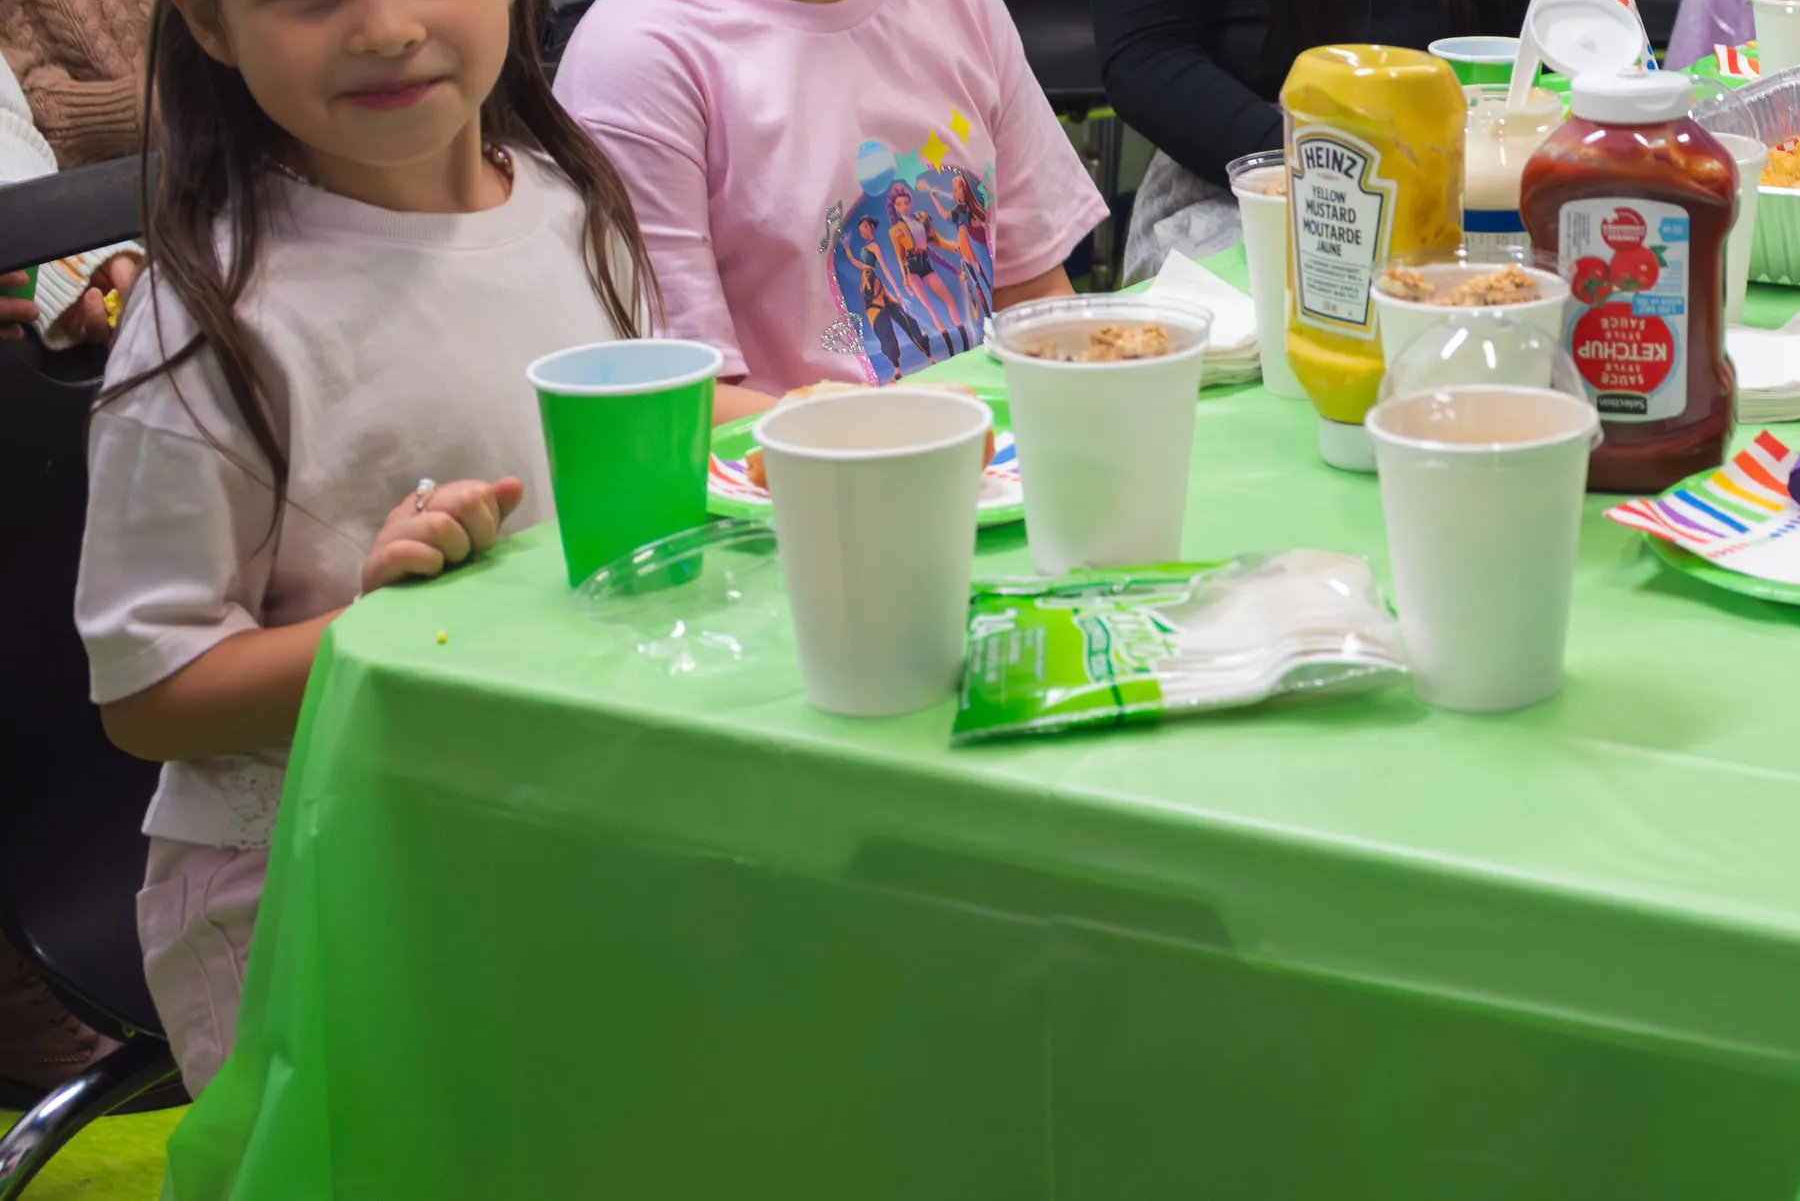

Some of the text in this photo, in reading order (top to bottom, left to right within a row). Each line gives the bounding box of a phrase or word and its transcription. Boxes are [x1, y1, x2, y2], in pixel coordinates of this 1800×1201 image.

[1304, 145, 1358, 180] HEINZ
[1311, 184, 1347, 204] YELLOW
[1305, 198, 1357, 225] MUSTARD
[1302, 217, 1363, 246] MOUTARDE
[1315, 239, 1343, 258] JAUNE
[1599, 316, 1646, 331] SAUCE
[1577, 340, 1668, 362] KETCHUP
[1604, 362, 1642, 373] STYLE
[1600, 371, 1645, 386] SAUCE
[1598, 397, 1646, 411] Selection
